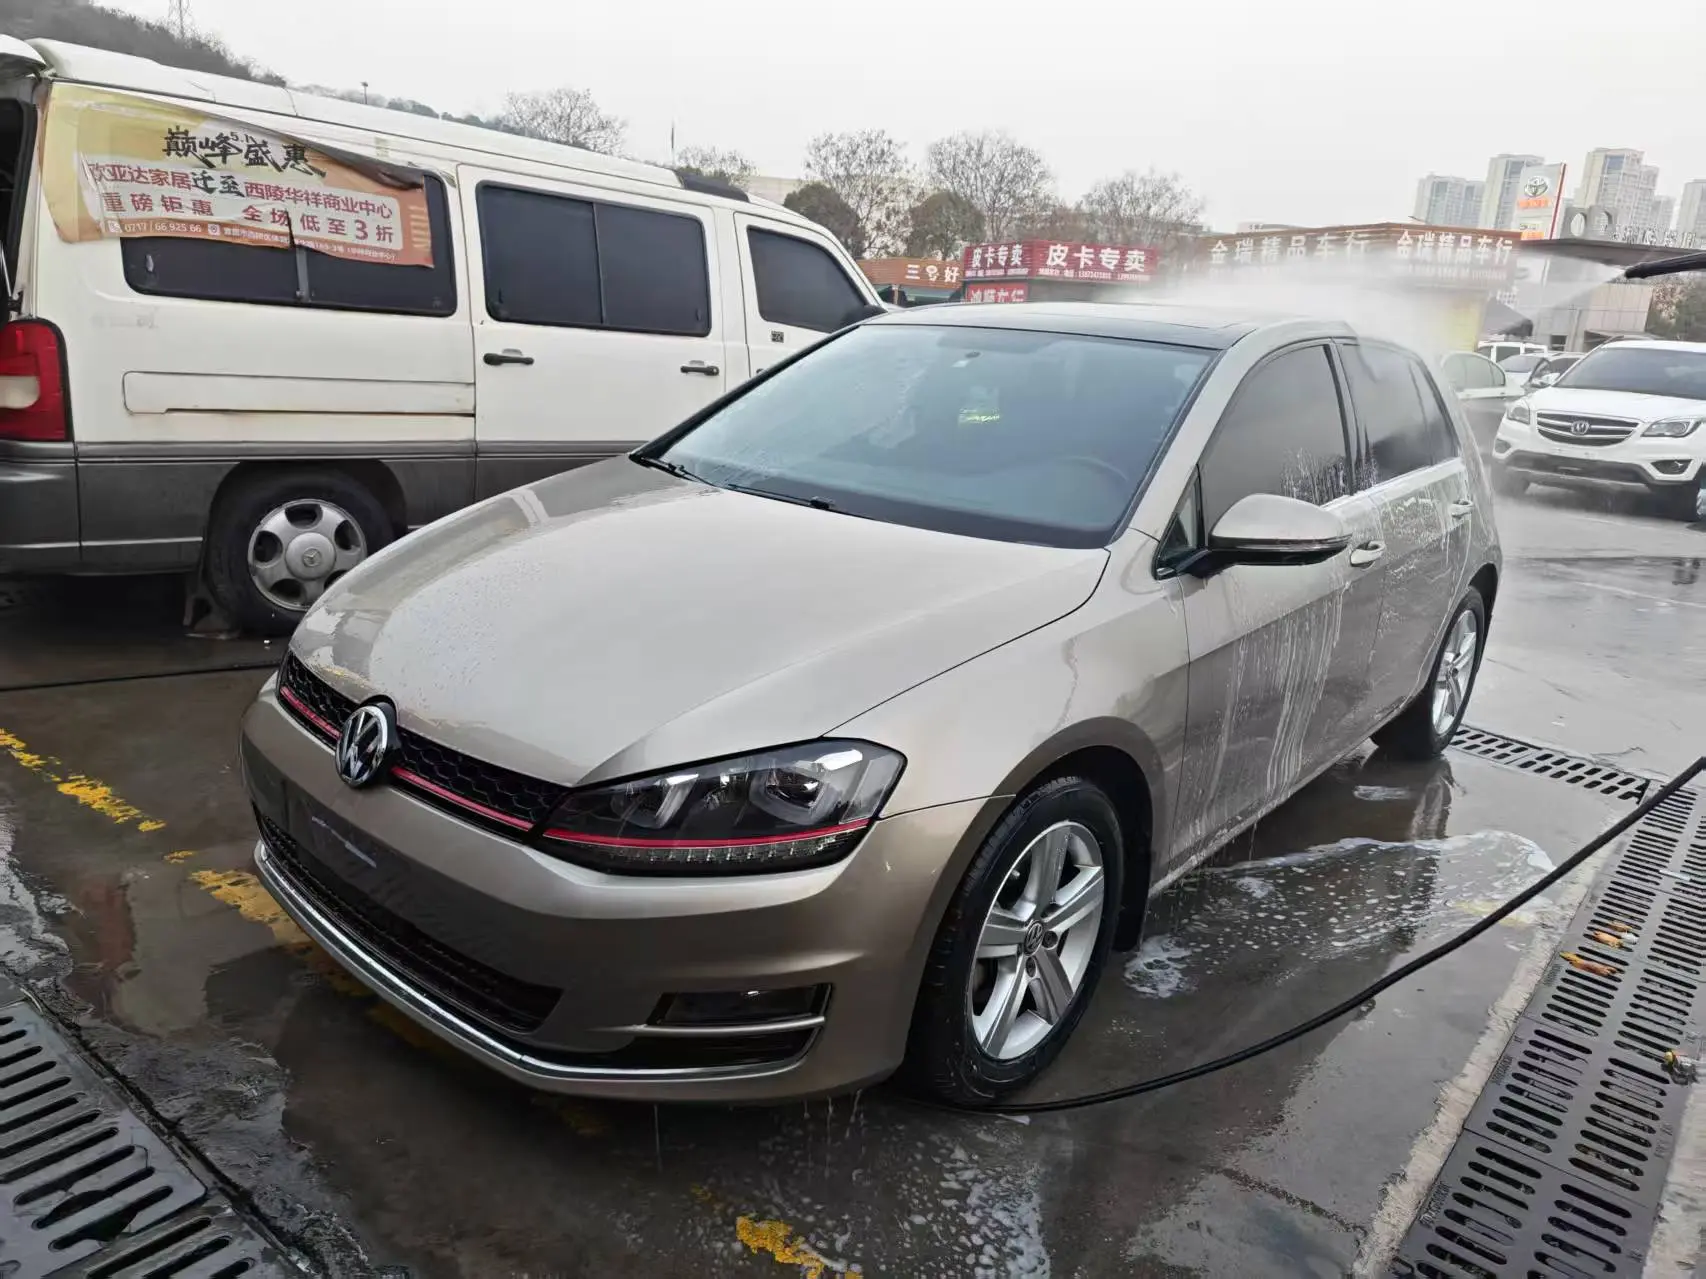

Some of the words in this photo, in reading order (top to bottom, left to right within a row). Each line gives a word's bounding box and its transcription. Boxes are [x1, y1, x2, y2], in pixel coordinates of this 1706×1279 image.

[163, 125, 327, 178] 巅峰盛惠
[104, 191, 214, 216] 重磅钜惠
[972, 244, 1023, 268] 皮卡专卖
[1046, 244, 1146, 272] 皮卡专卖
